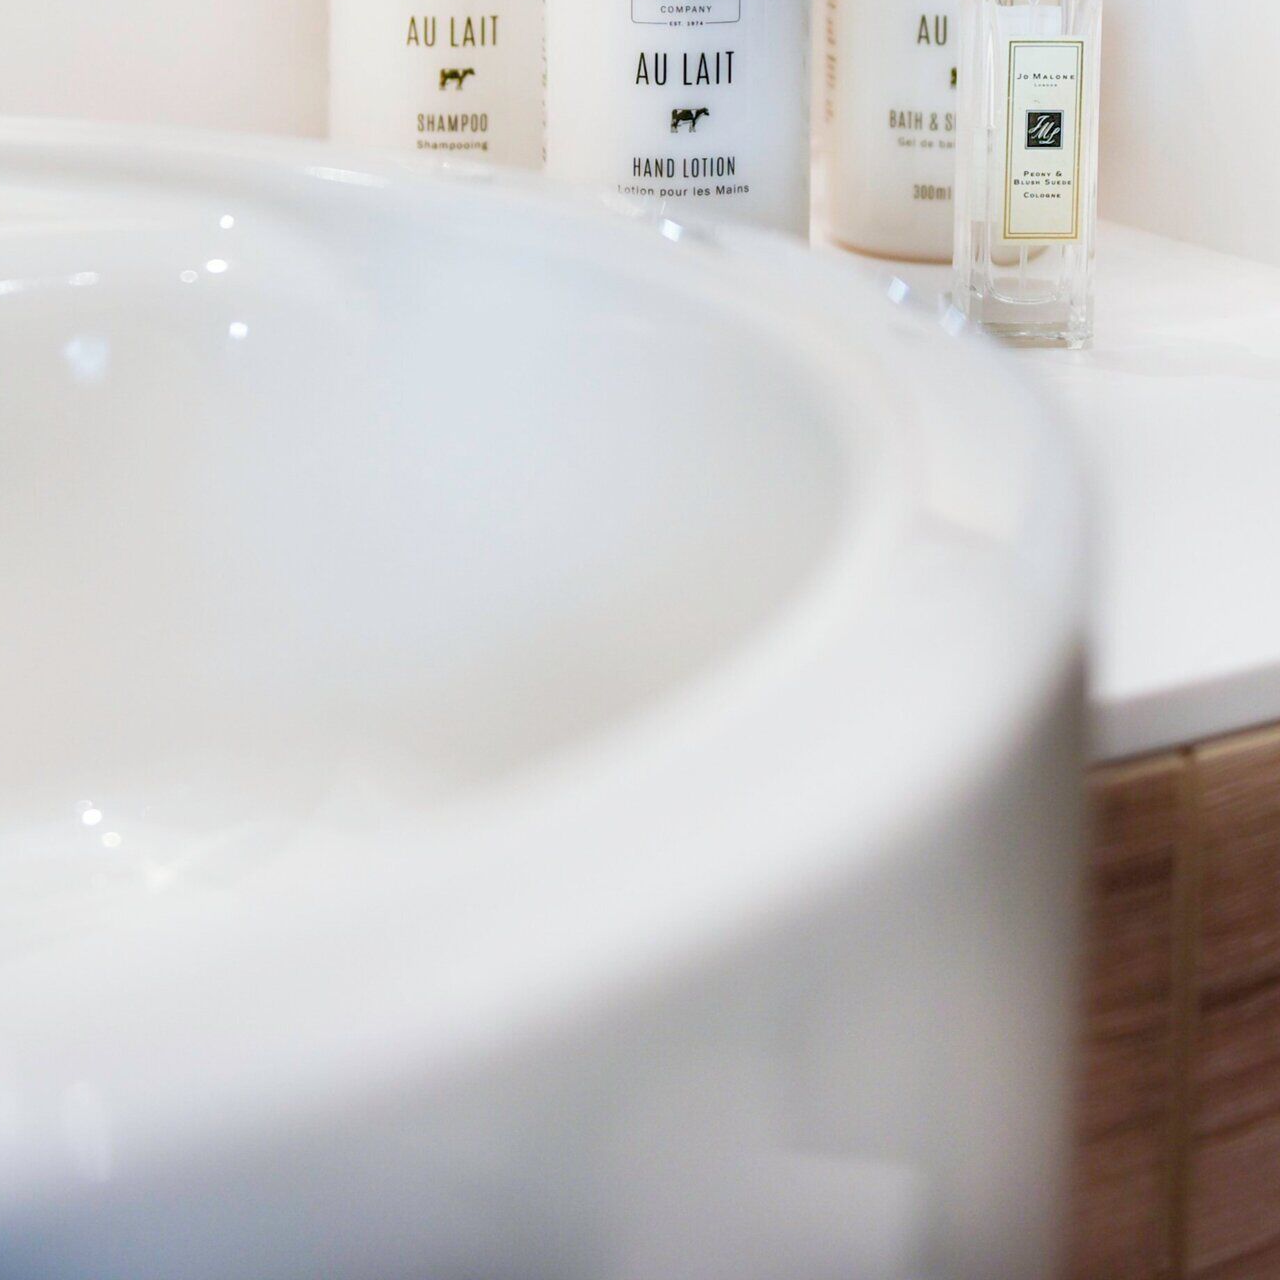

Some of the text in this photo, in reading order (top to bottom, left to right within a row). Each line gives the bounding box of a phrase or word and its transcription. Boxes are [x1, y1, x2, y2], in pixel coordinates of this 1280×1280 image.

[660, 5, 713, 14] COMPANY
[406, 14, 499, 48] AU LAIT
[916, 14, 948, 47] AU
[635, 50, 735, 86] AU LAIT
[1032, 72, 1075, 80] MALONE
[417, 112, 488, 133] SHAMPOO
[889, 109, 923, 131] BATH
[928, 112, 939, 132] &
[417, 140, 489, 152] Shampooing
[632, 156, 736, 179] HAND LOTION
[1023, 170, 1063, 178] PEONY &
[1013, 178, 1072, 186] BLUSH SUEDE
[659, 188, 688, 198] pour
[692, 186, 711, 197] les
[715, 184, 750, 196] Mains
[912, 183, 952, 201] 300ml
[1023, 191, 1062, 199] COLOGNE
